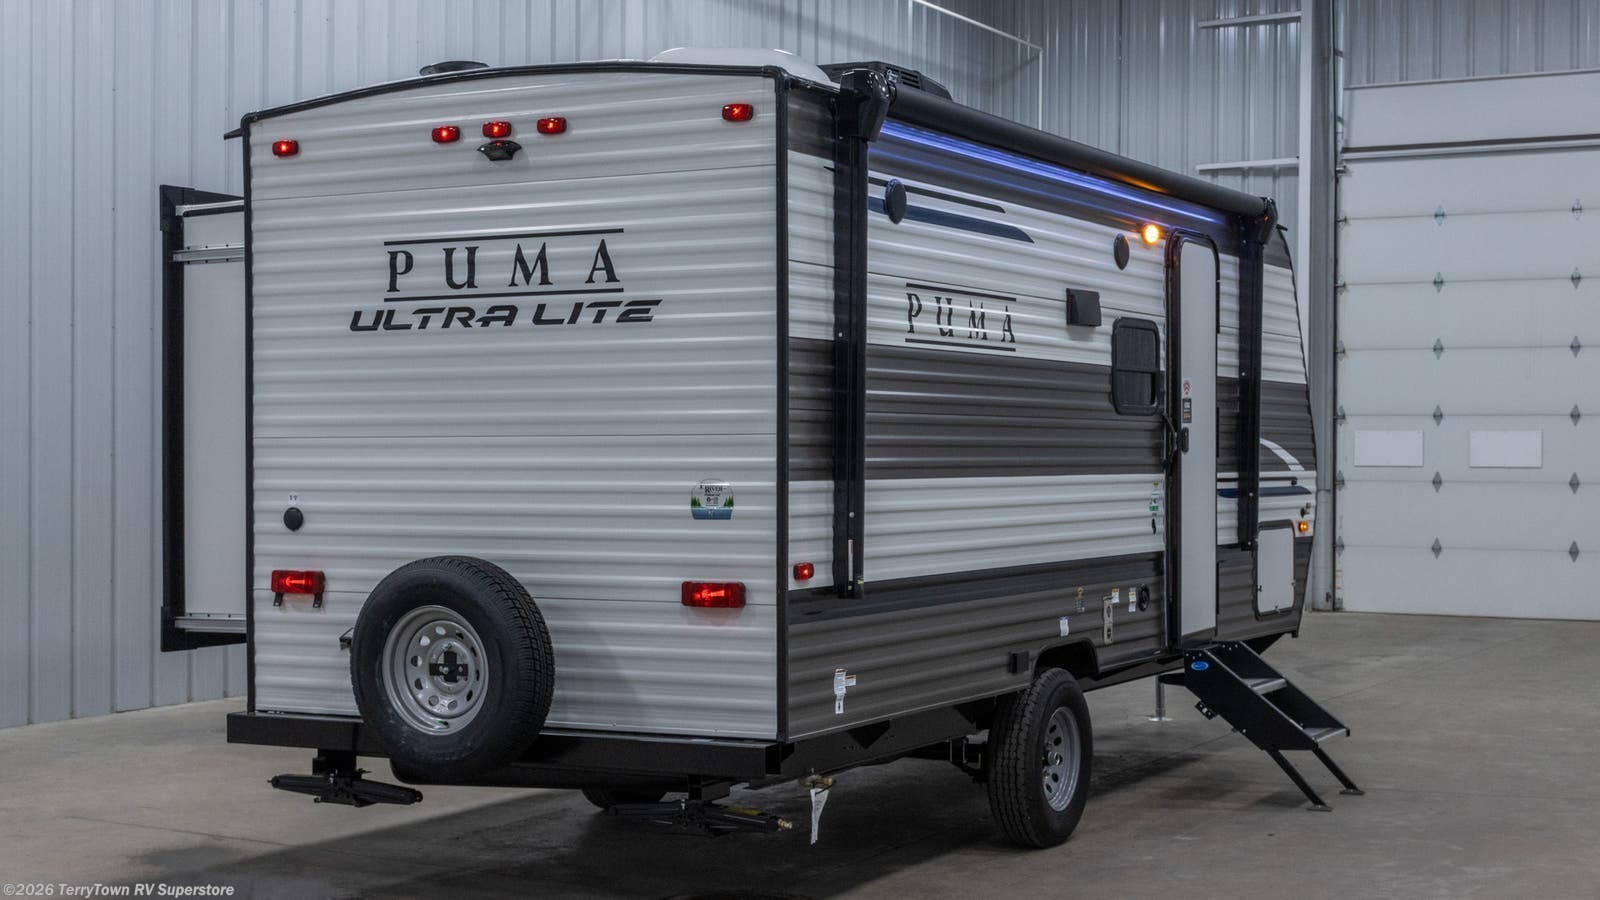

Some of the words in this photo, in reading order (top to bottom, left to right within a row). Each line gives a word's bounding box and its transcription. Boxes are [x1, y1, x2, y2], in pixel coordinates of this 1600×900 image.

[386, 238, 621, 293] PUMA
[349, 305, 519, 332] ULTRA
[532, 299, 663, 326] LITE
[905, 292, 1016, 343] PUMA
